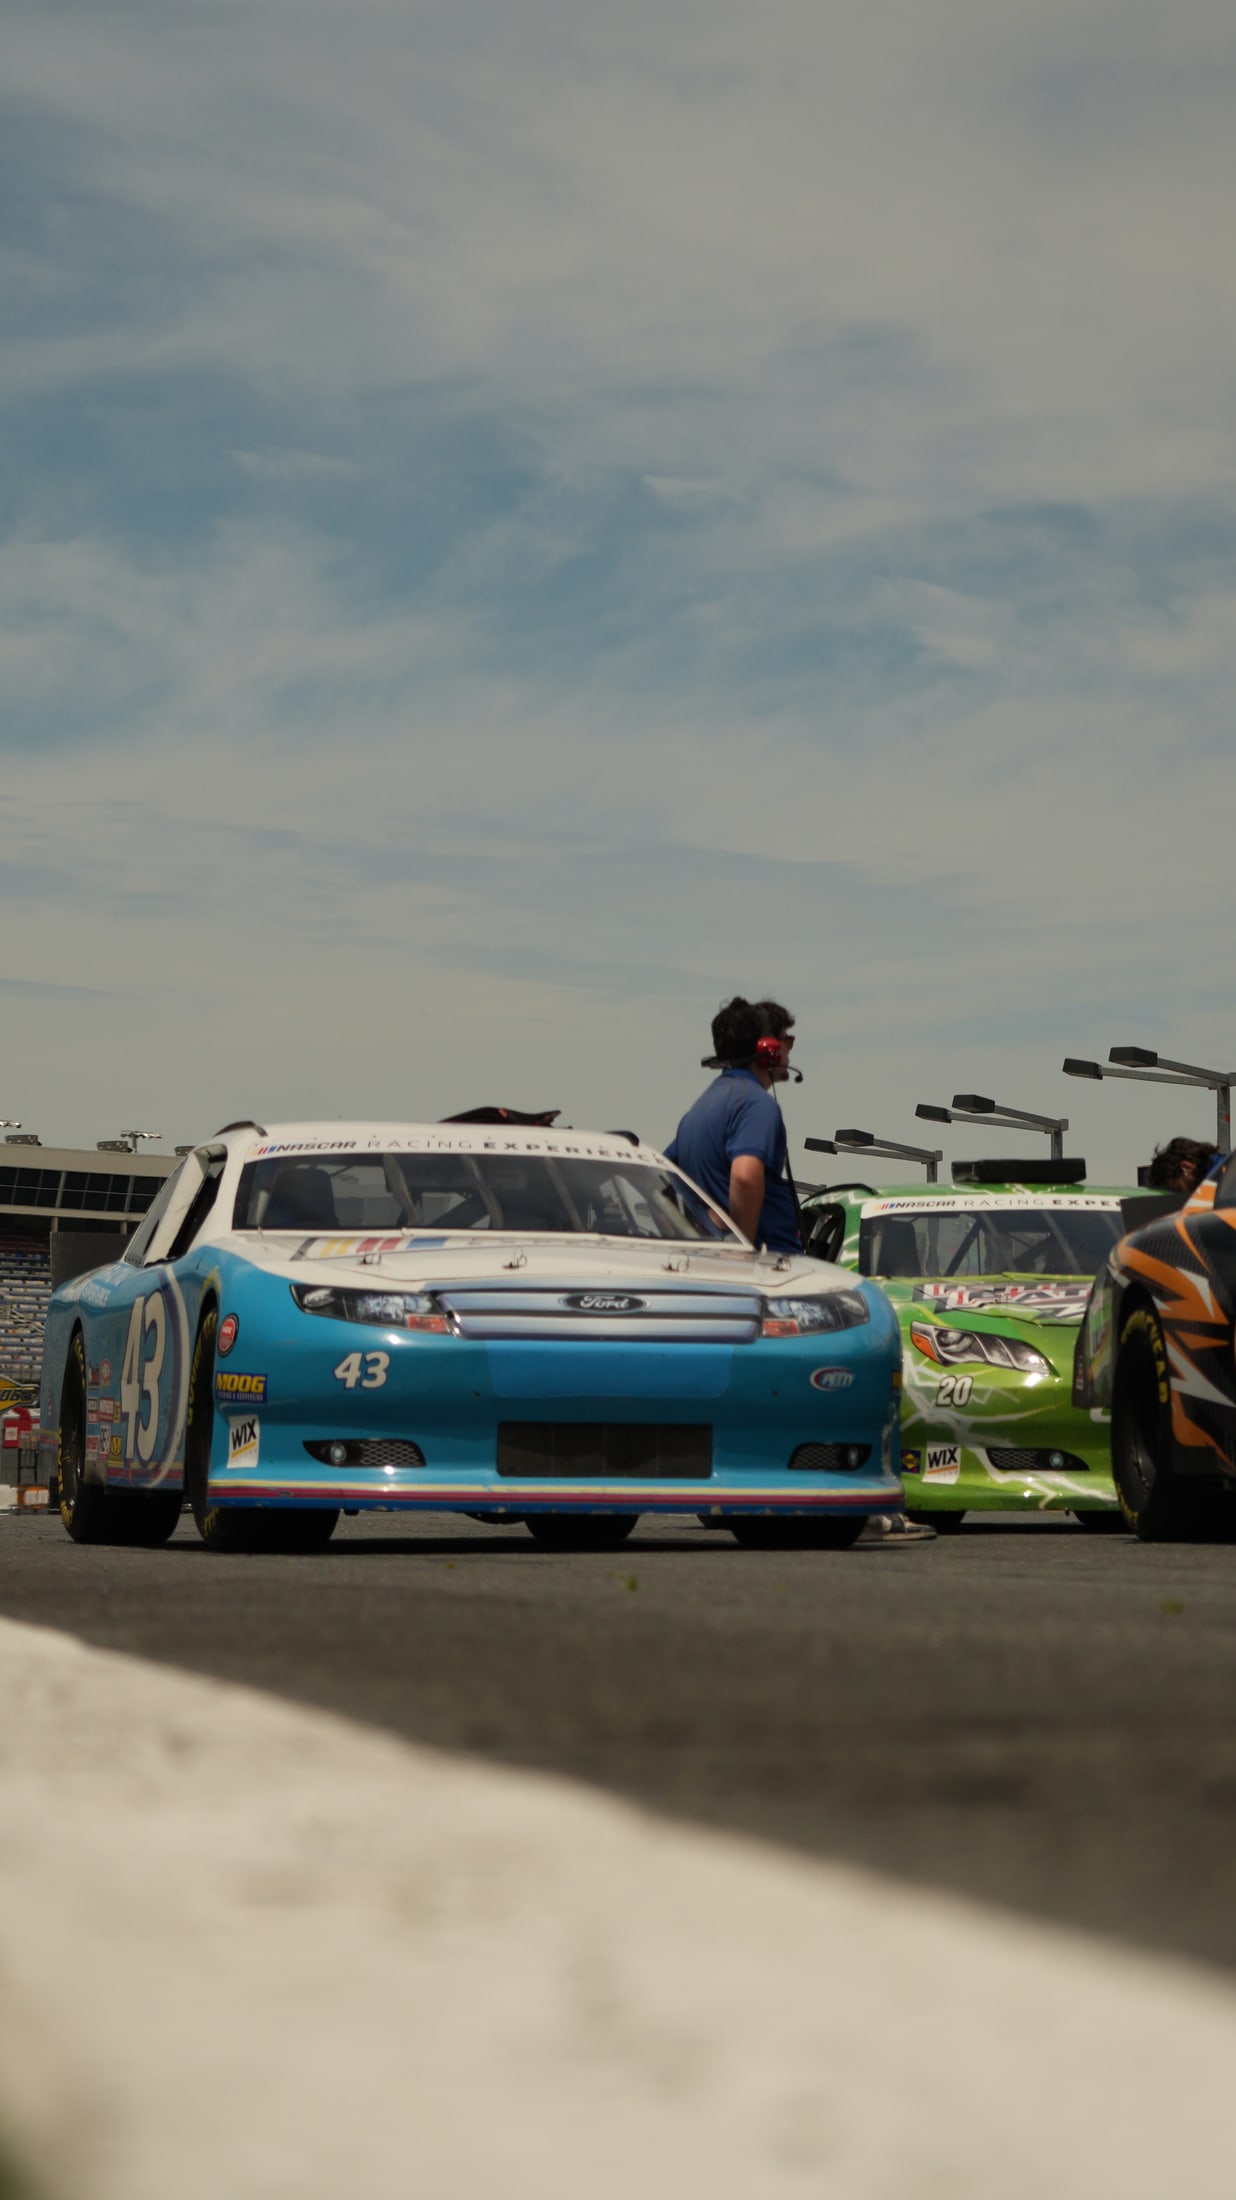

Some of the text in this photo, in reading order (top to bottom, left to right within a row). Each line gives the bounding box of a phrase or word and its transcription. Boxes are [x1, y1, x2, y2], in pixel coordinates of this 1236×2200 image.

[276, 1140, 667, 1164] NASCAR RACING EXPERIENCE
[894, 1200, 956, 1209] NASCAR
[964, 1199, 1046, 1207] RACING
[580, 1295, 630, 1309] Ford
[121, 1291, 166, 1462] 43
[333, 1351, 391, 1389] 43
[216, 1373, 266, 1393] MOOG
[936, 1376, 973, 1407] 20
[231, 1419, 257, 1450] WIX
[928, 1447, 959, 1469] WIX
